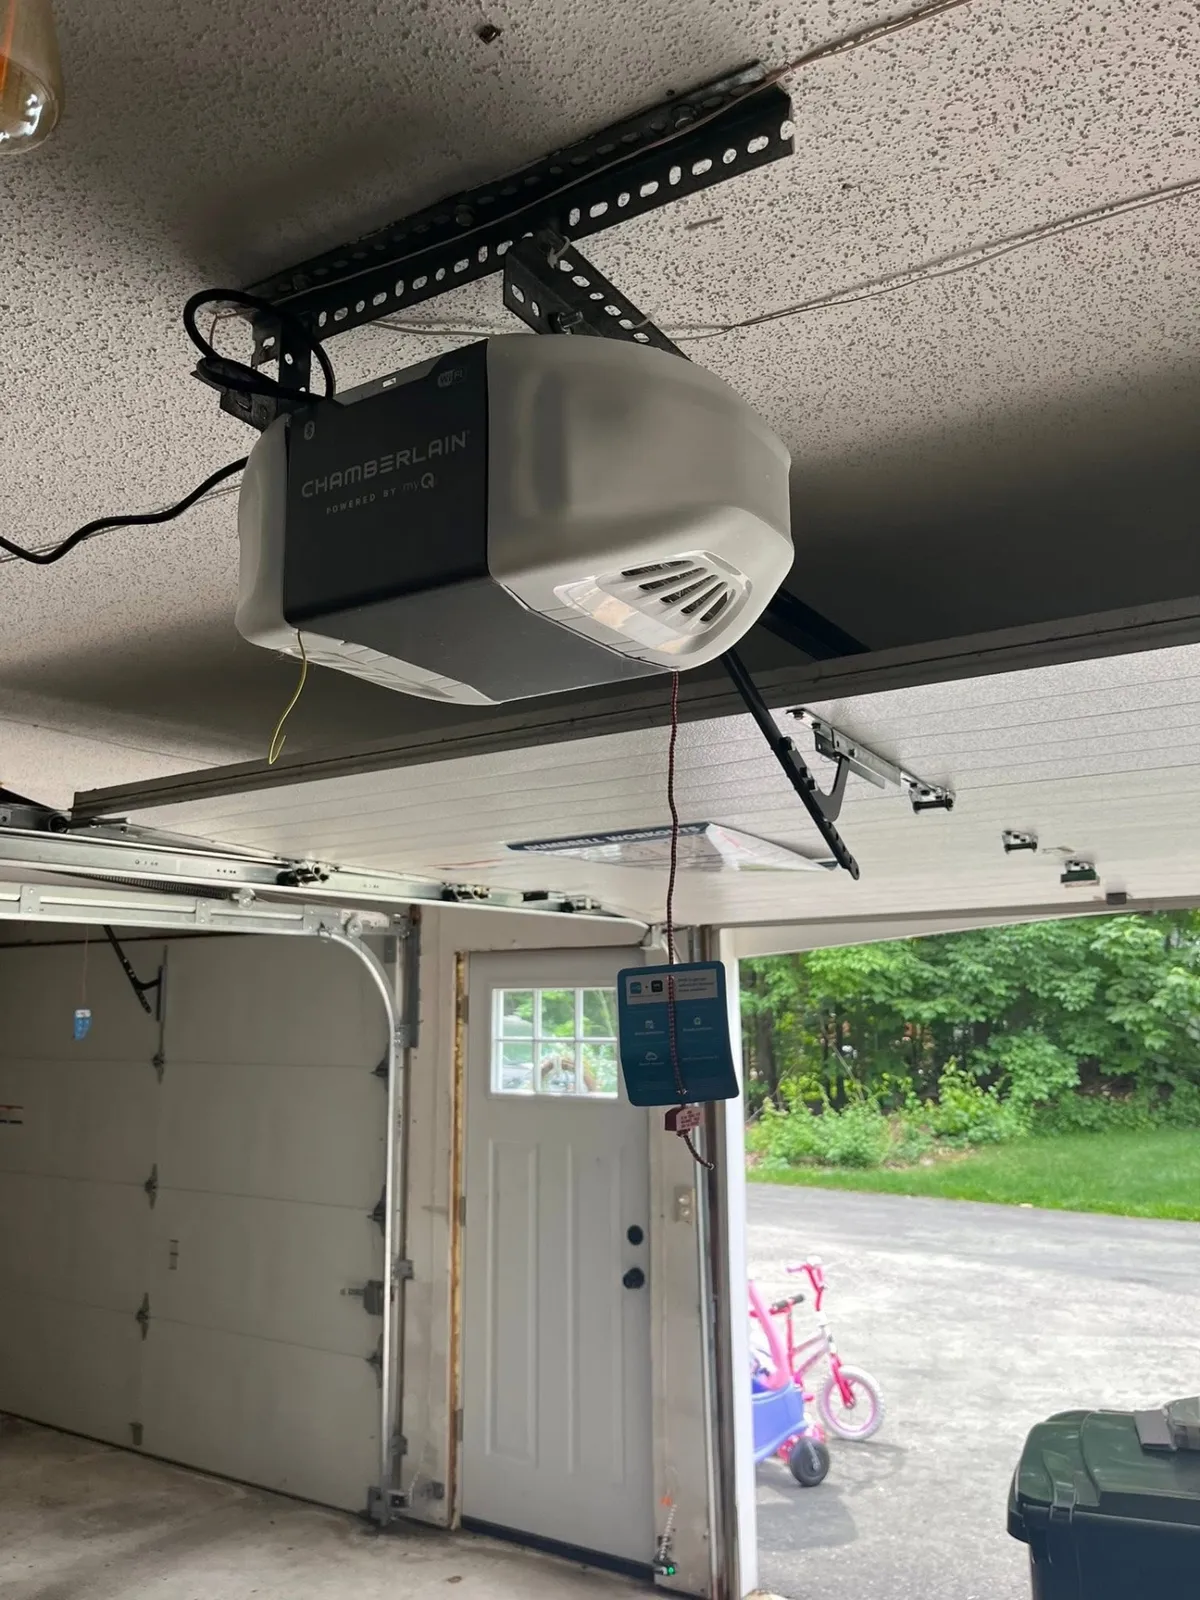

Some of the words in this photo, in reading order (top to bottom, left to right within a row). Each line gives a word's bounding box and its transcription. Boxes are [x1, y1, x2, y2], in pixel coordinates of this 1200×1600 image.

[301, 430, 467, 498] CHAMBERLAIN
[325, 492, 376, 515] POWERED
[383, 487, 397, 499] BY
[402, 472, 436, 493] myQ
